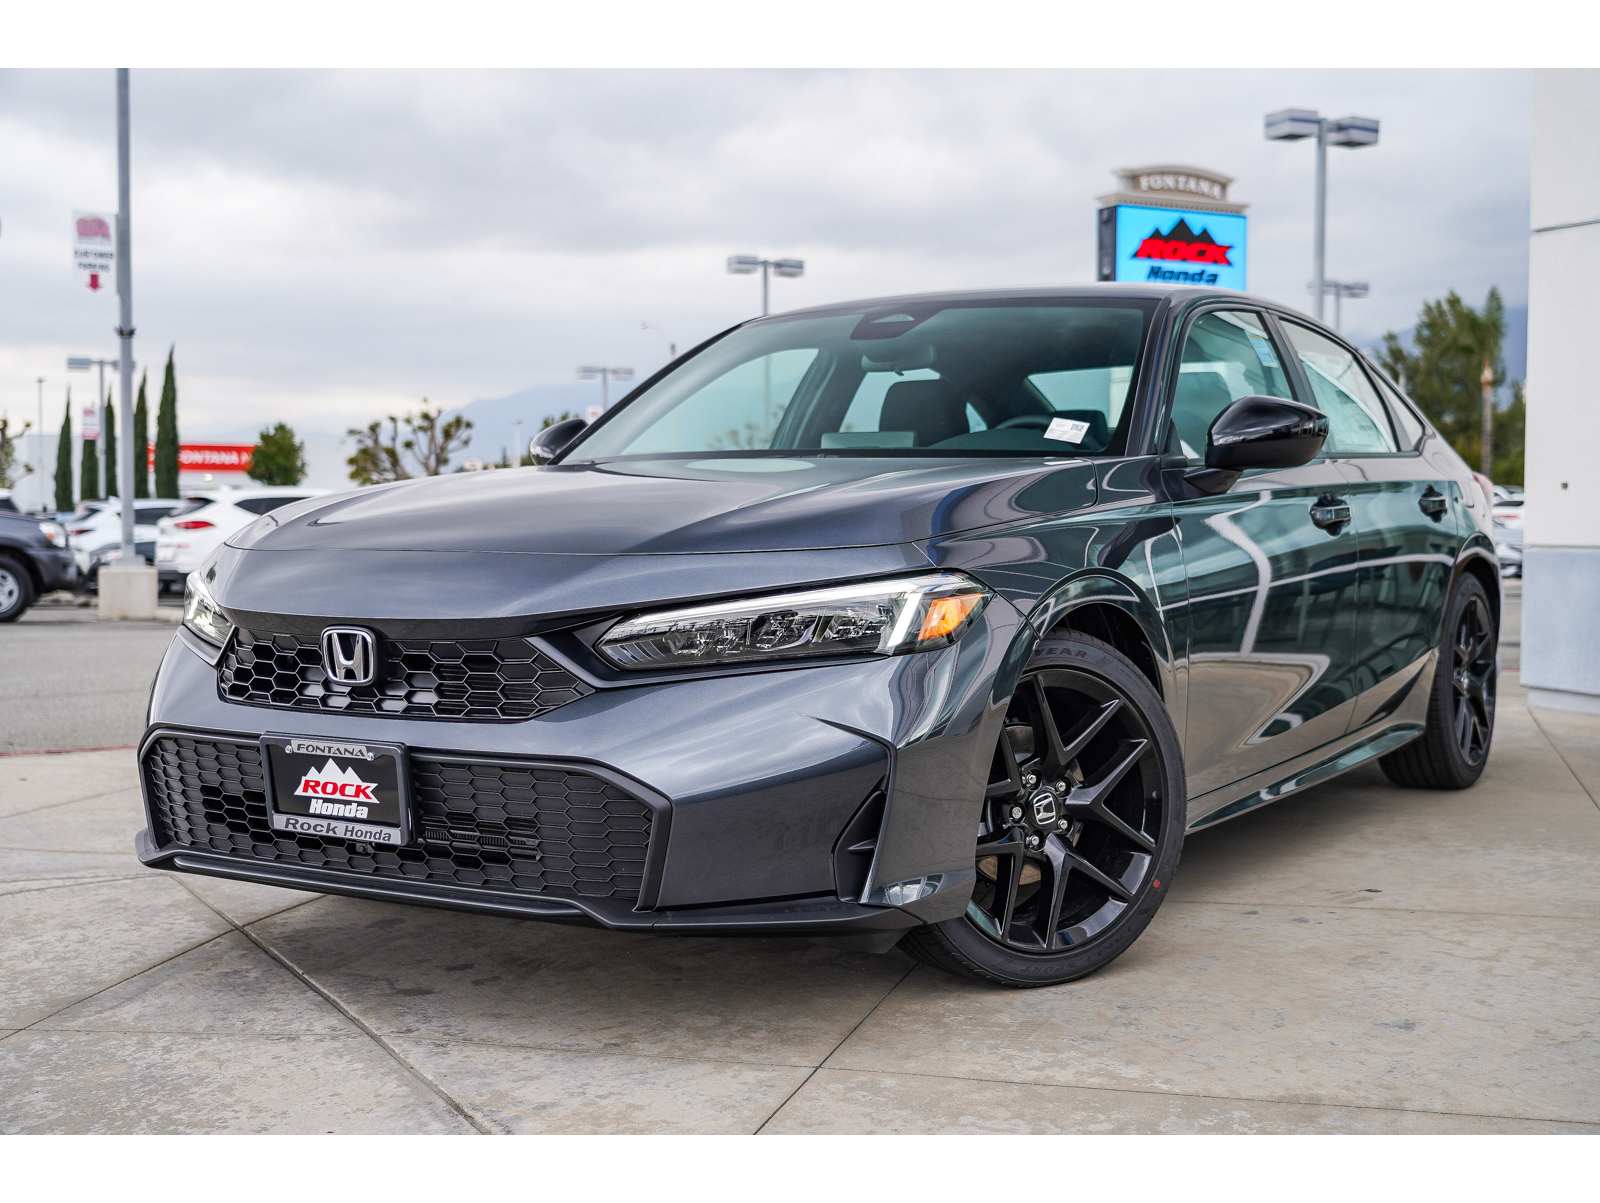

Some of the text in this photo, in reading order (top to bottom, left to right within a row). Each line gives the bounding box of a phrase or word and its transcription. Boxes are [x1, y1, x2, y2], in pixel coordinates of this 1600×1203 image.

[1139, 174, 1221, 199] FONTANA
[1147, 265, 1219, 284] Honda
[178, 450, 239, 465] ONTANA
[296, 743, 366, 758] FONTANA
[302, 779, 373, 800] ROCK
[309, 798, 369, 819] Honda
[284, 817, 392, 842] Rock Honda
